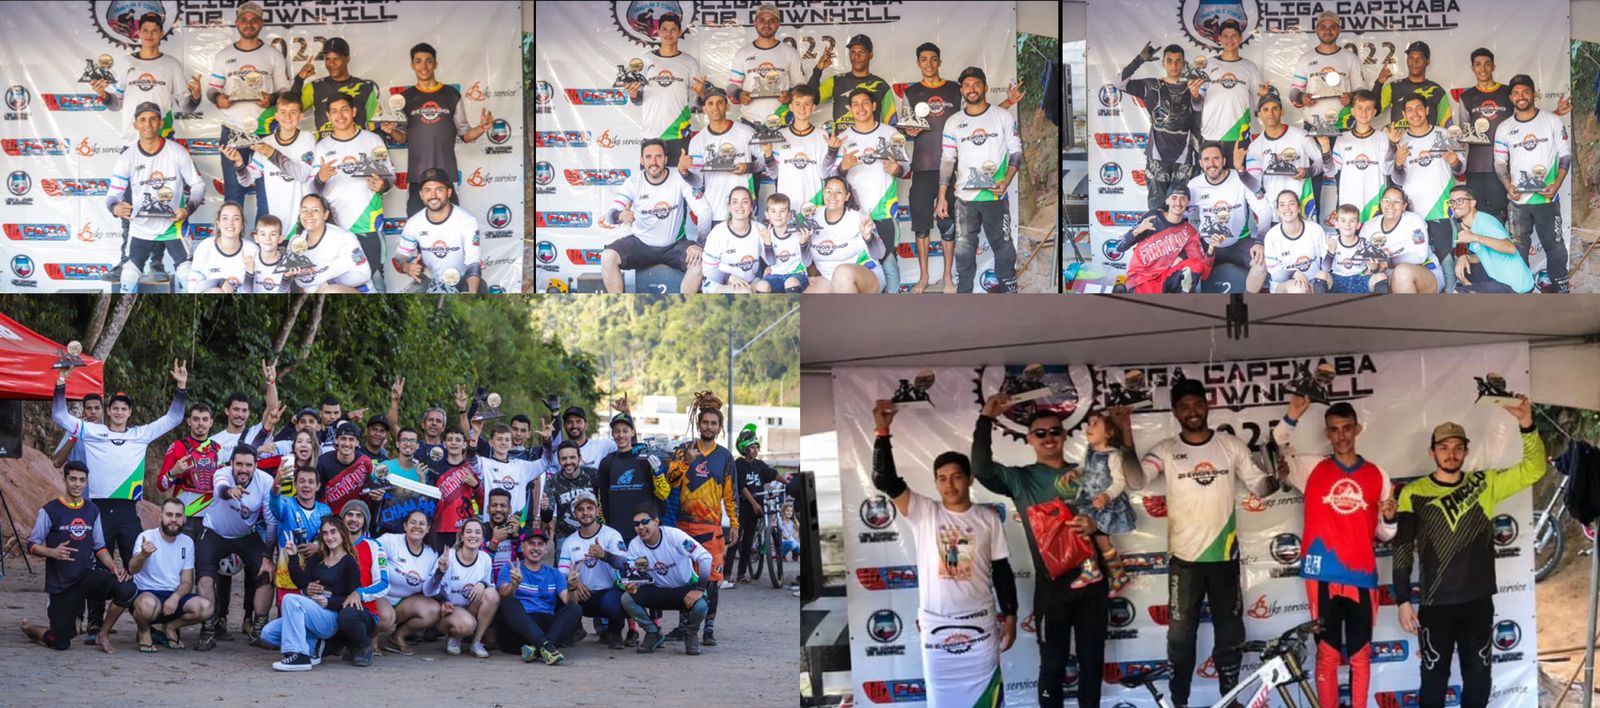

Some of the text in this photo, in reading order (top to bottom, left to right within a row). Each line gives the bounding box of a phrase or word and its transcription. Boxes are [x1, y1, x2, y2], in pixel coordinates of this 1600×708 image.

[1265, 0, 1460, 16] LIGA CAPIXABA
[1007, 678, 1038, 691] service
